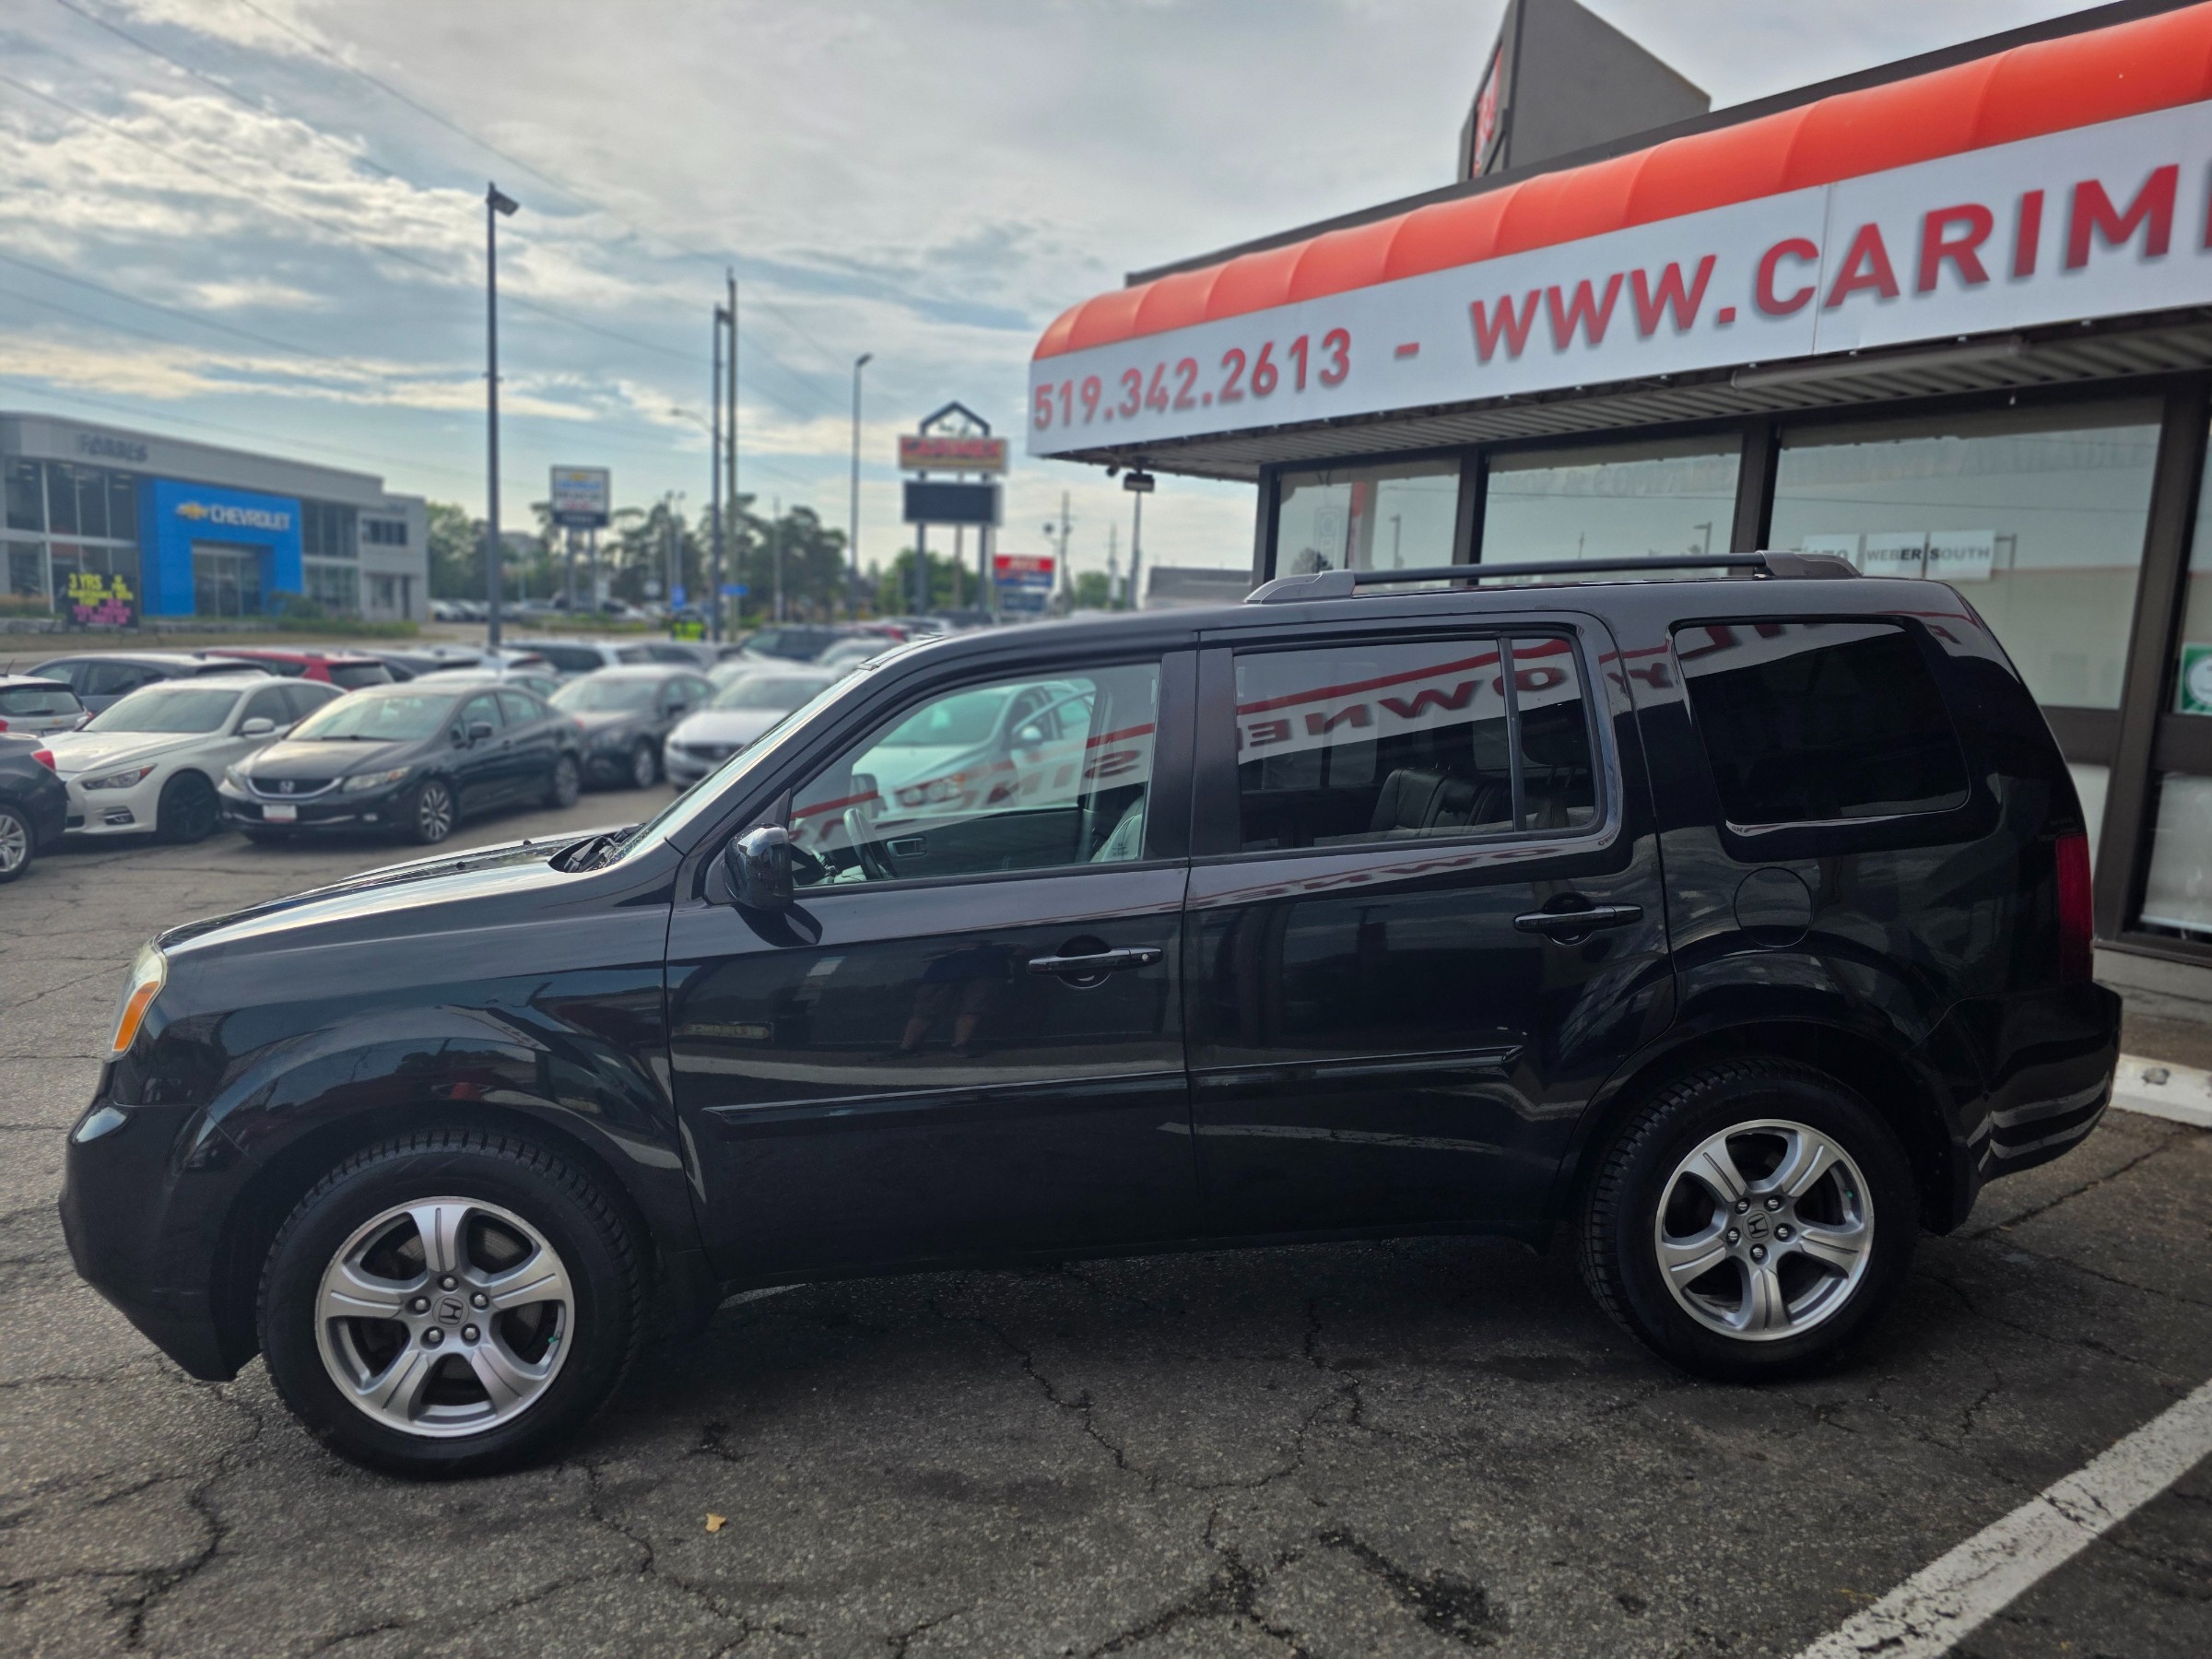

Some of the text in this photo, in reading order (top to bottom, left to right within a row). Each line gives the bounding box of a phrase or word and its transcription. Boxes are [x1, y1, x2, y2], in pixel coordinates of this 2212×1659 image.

[1033, 327, 1352, 429] 519.342.2613
[1470, 163, 2212, 363] WWW.CARIM
[210, 505, 291, 531] CHEVROLET
[1866, 547, 1922, 561] WEBER
[1929, 546, 1990, 561] SOUTH
